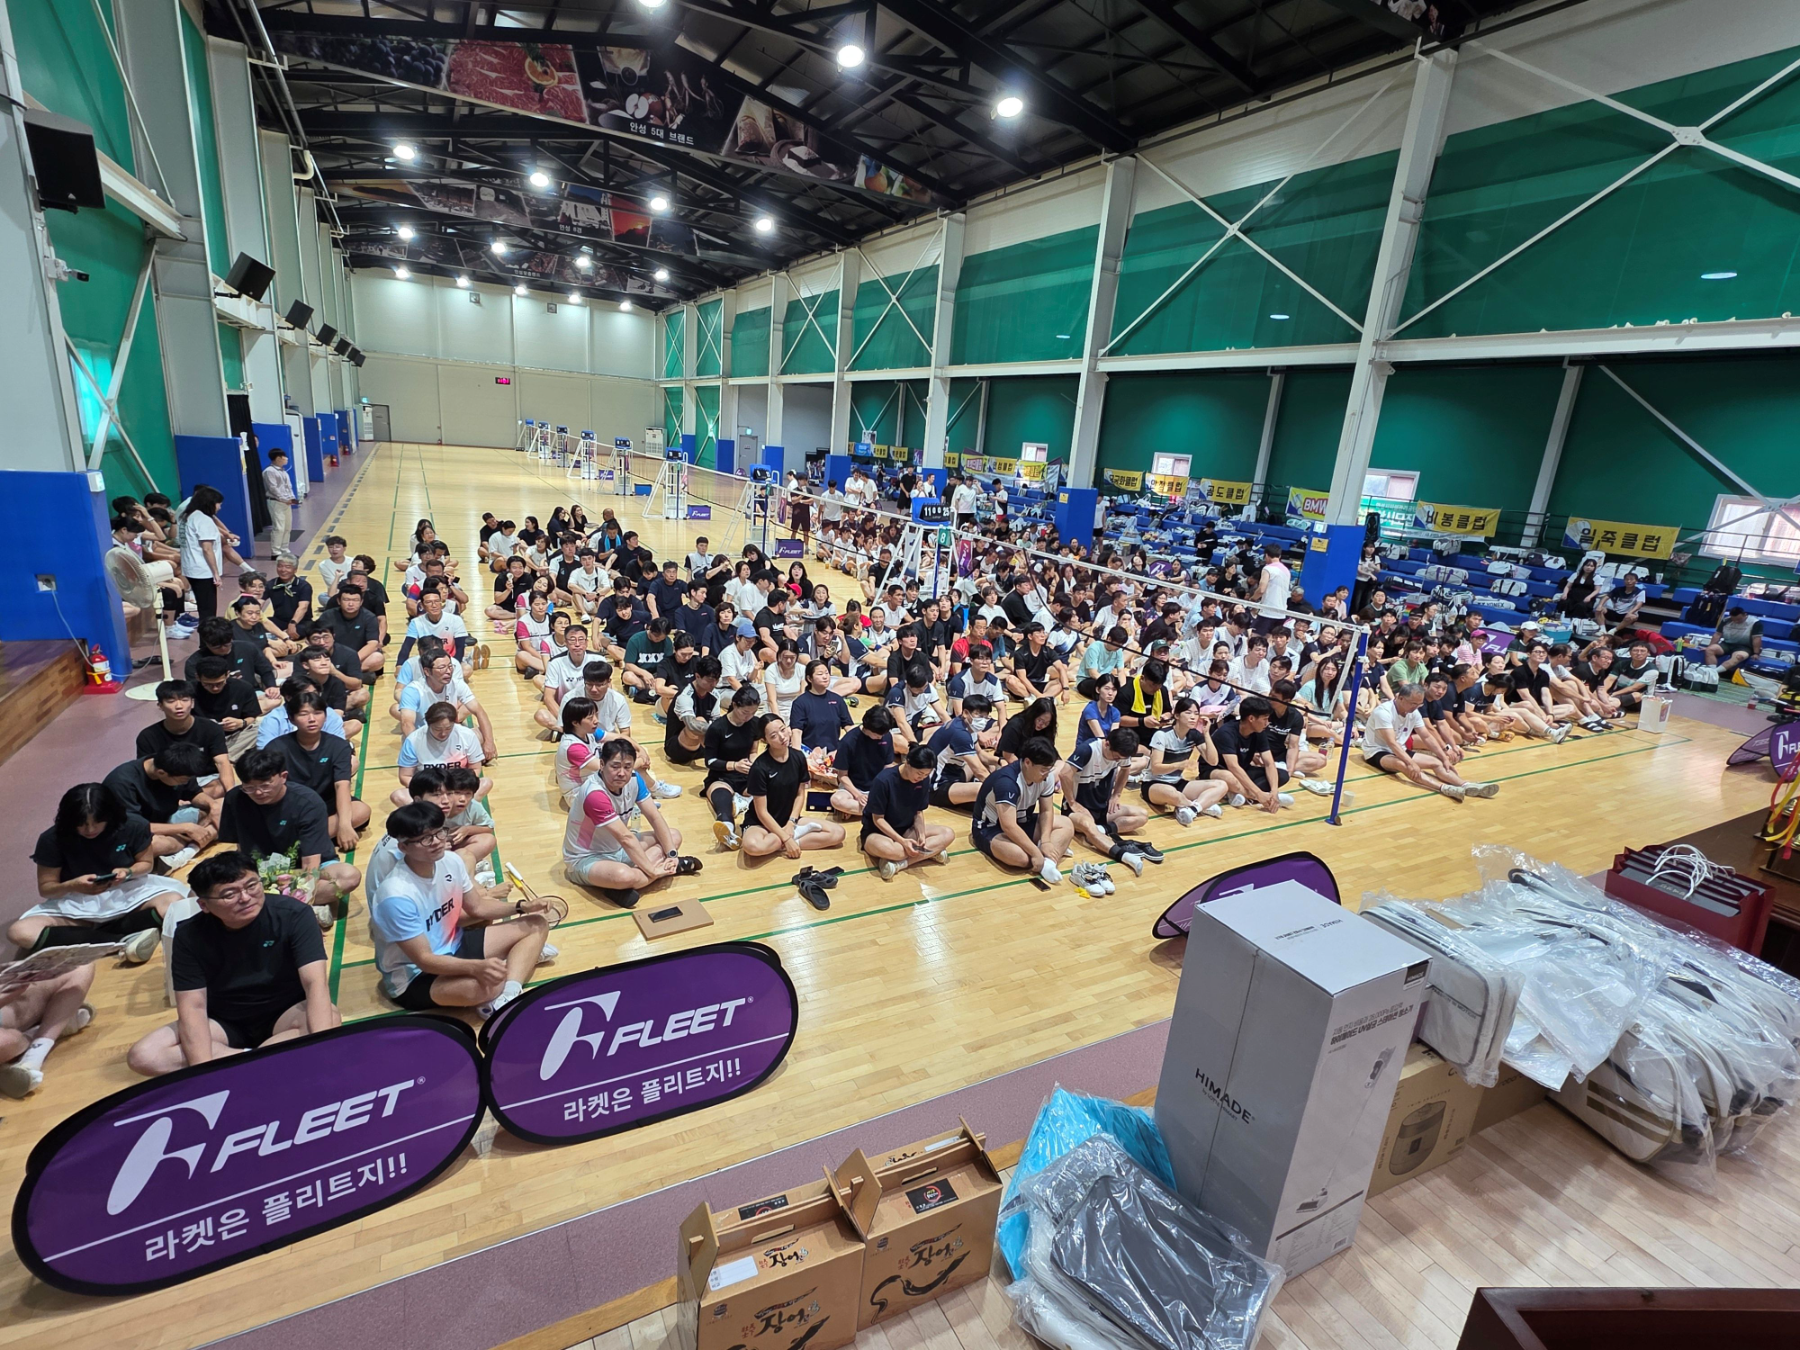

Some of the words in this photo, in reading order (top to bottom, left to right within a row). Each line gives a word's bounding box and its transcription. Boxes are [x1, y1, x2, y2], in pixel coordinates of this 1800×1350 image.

[629, 122, 647, 135] 안성
[650, 127, 665, 139] 5대
[668, 131, 694, 146] 브랜드
[1206, 485, 1245, 500] 공도클럽
[1425, 510, 1487, 531] 비봉클럽
[940, 532, 946, 543] 8
[1579, 527, 1662, 553] 일죽클럽
[606, 997, 746, 1057] FLEET
[563, 1086, 634, 1123] 라켓은
[640, 1057, 742, 1105] 플리트지!!
[1195, 1067, 1252, 1124] HIMADE
[209, 1079, 415, 1174] FLEET
[145, 1207, 250, 1264] 라켓은
[260, 1152, 408, 1227] 플리트지!!
[768, 1250, 801, 1269] 장어
[906, 1242, 951, 1270] 장어
[753, 1307, 806, 1339] 장어
